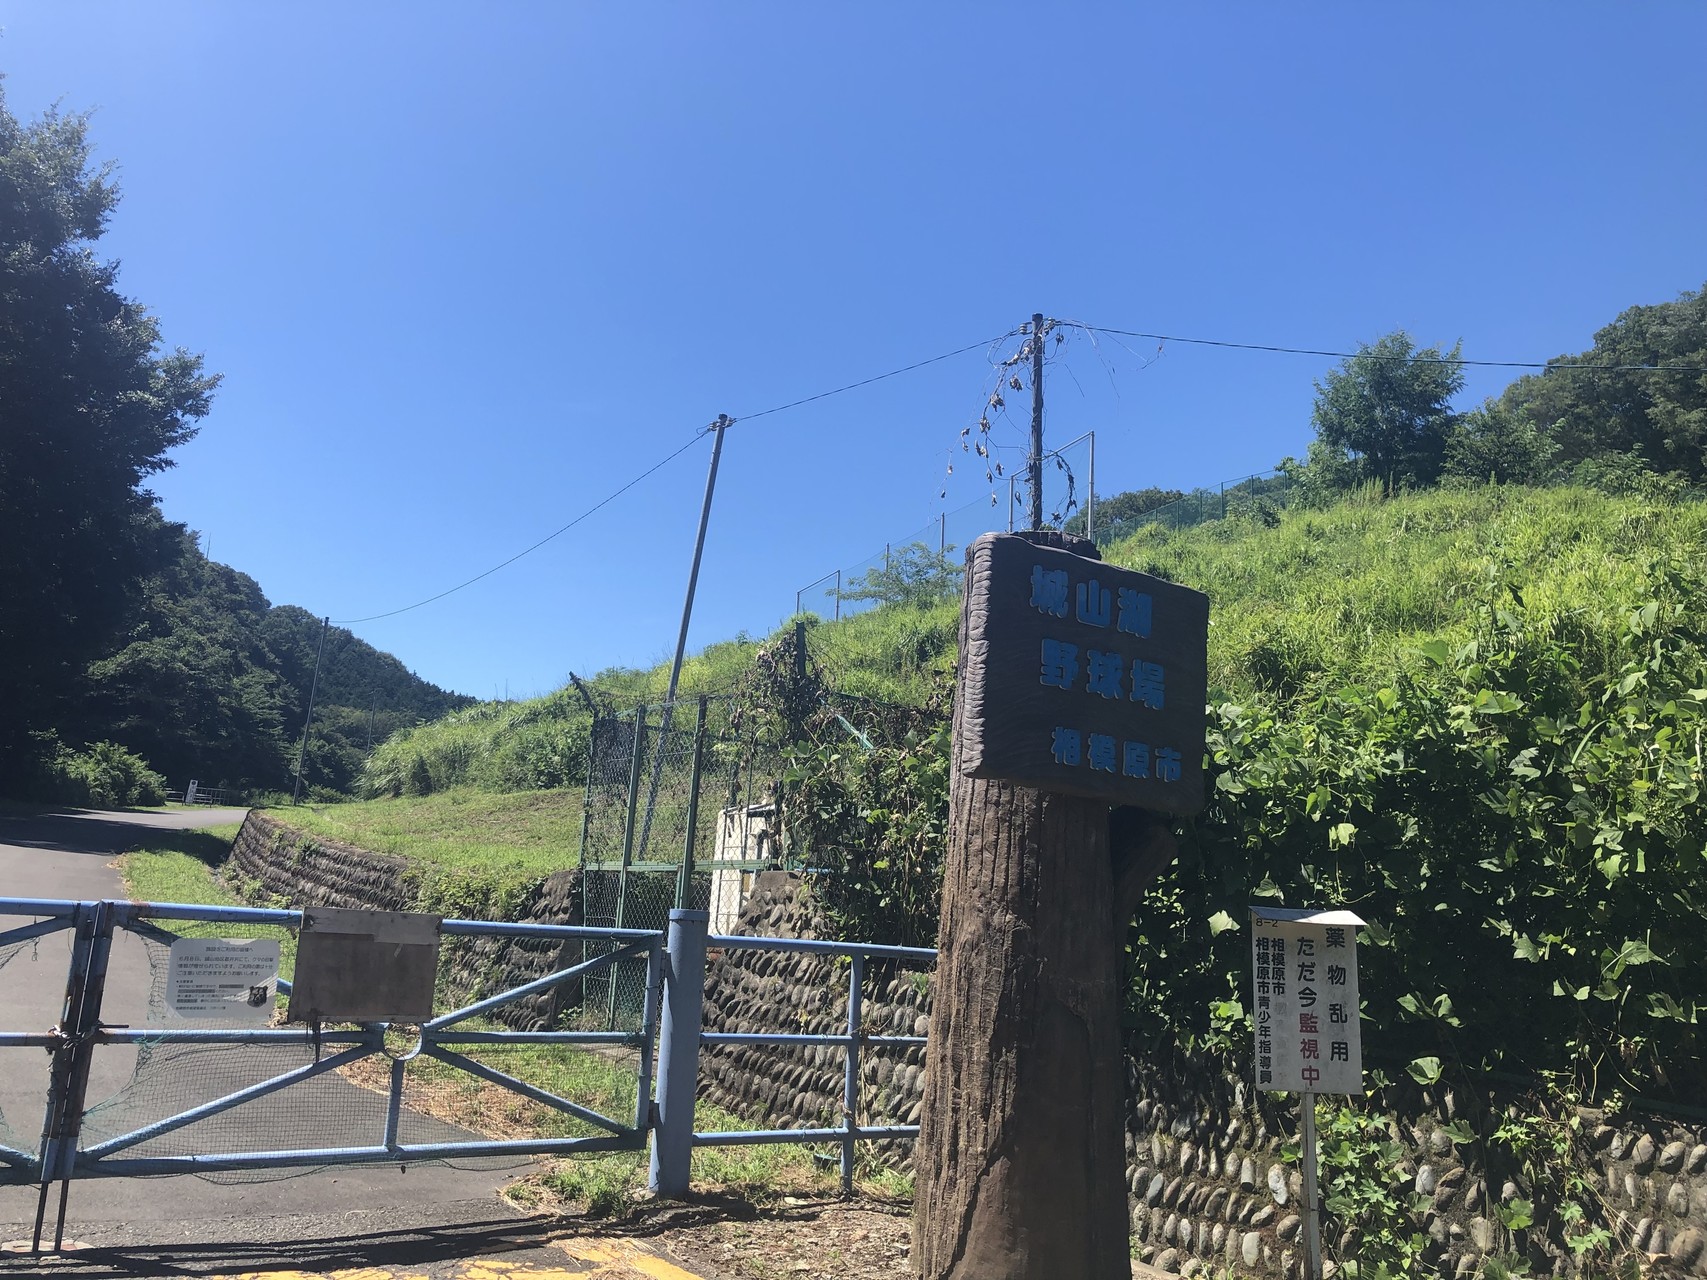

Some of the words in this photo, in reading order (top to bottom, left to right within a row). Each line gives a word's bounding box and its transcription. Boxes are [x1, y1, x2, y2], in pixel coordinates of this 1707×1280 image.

[1030, 564, 1152, 639] 城山湖
[1040, 638, 1165, 710] 野球場
[1051, 726, 1182, 783] 相模原市
[1271, 938, 1286, 996] 相模原市
[1325, 926, 1349, 1062] 薬物乱用
[1255, 937, 1272, 1085] 相模原市青少年指導員
[1296, 936, 1320, 1087] ただ今監視中
